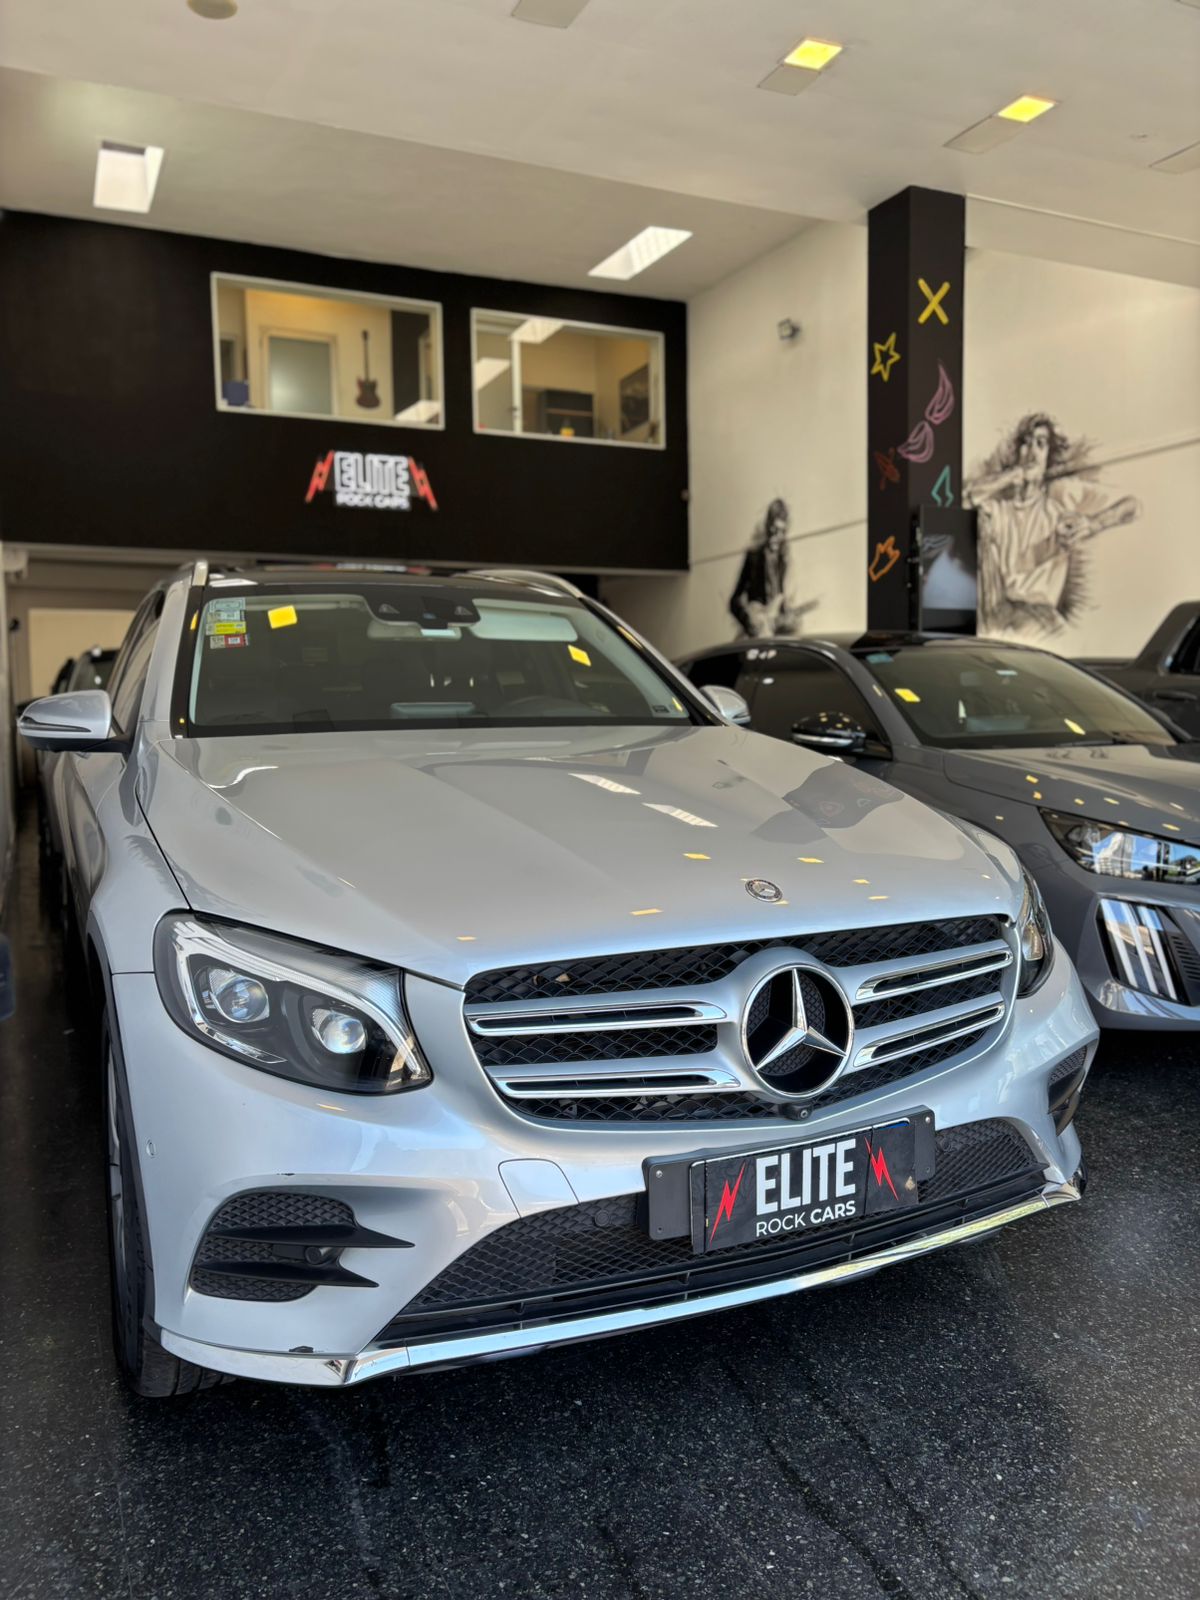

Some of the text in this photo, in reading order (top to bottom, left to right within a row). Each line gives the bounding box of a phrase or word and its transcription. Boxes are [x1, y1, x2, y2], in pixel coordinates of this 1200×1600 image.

[334, 451, 410, 496] ELITE
[756, 1138, 856, 1215] ELITE
[756, 1200, 856, 1237] ROCK CARS
